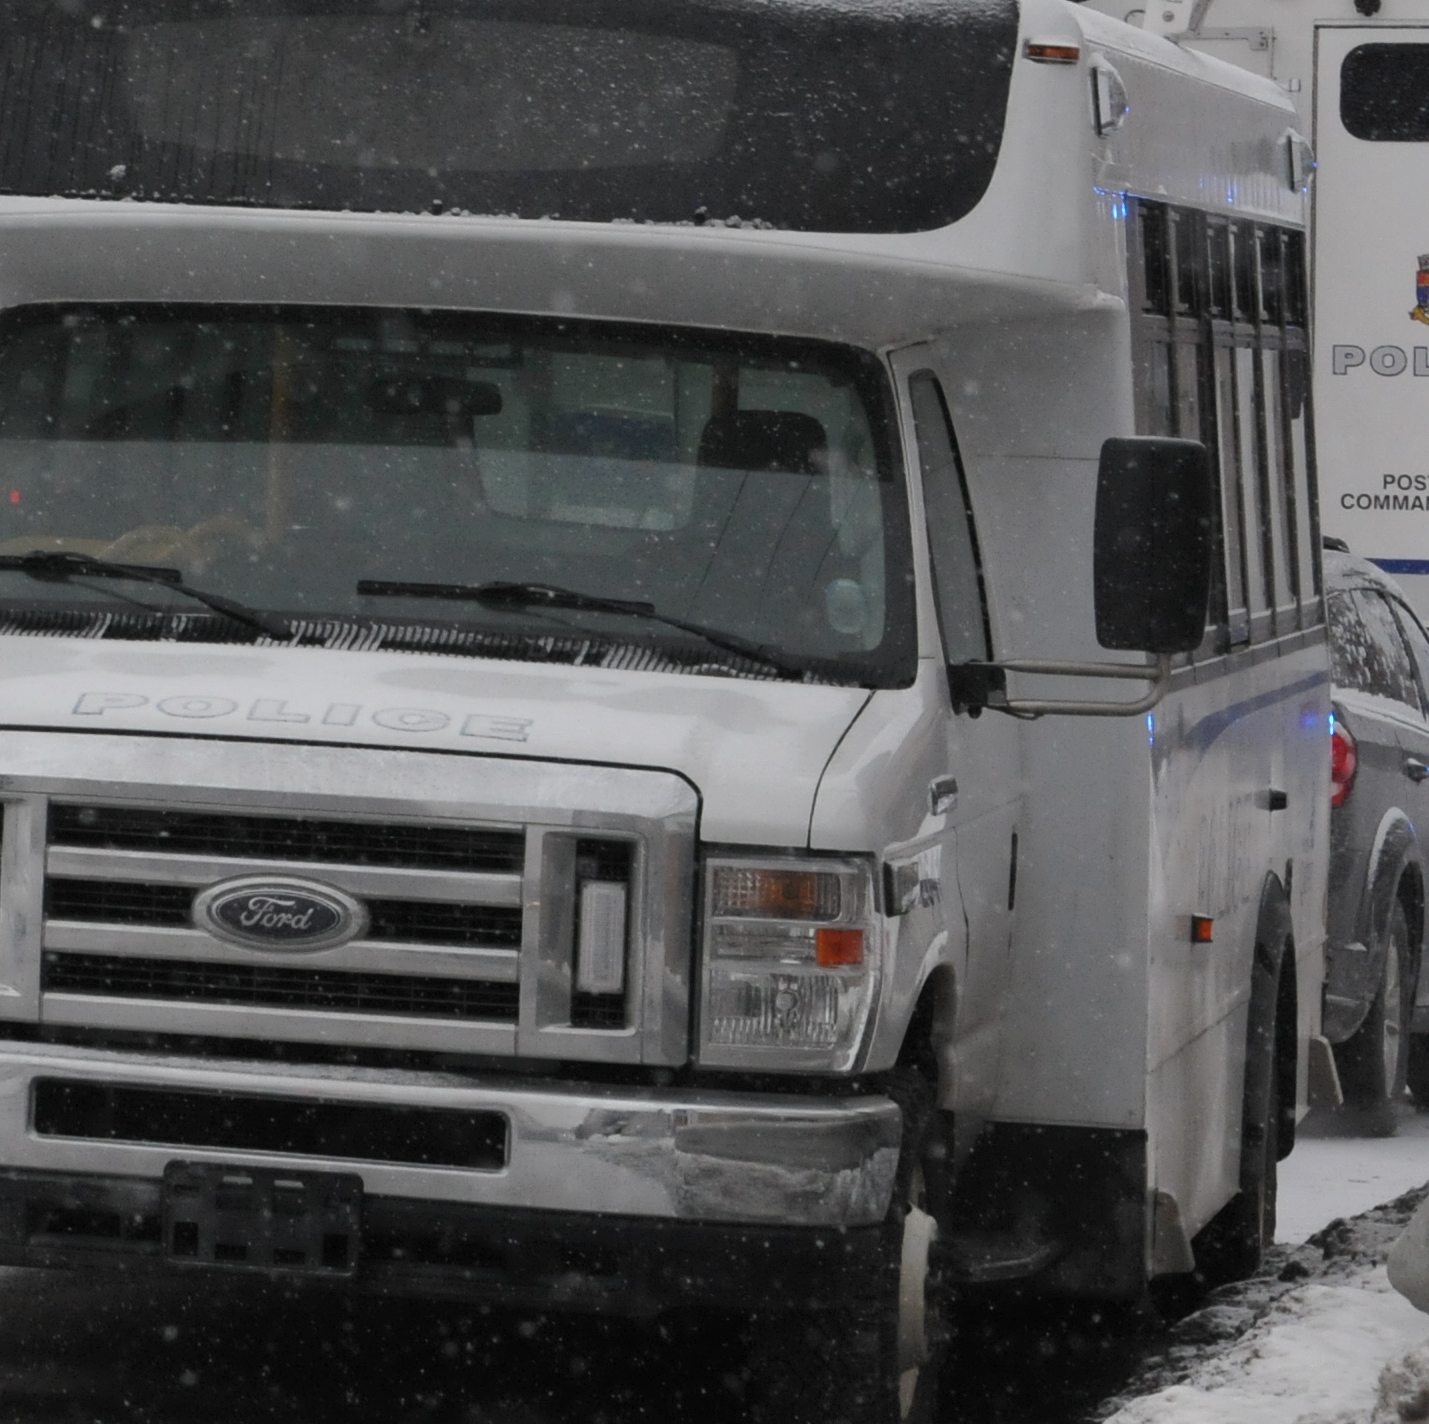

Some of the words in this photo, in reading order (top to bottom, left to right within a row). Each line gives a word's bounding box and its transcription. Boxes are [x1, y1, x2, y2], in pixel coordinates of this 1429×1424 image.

[1383, 474, 1429, 491] POS
[71, 692, 536, 742] POLICE
[240, 896, 315, 930] Ford
